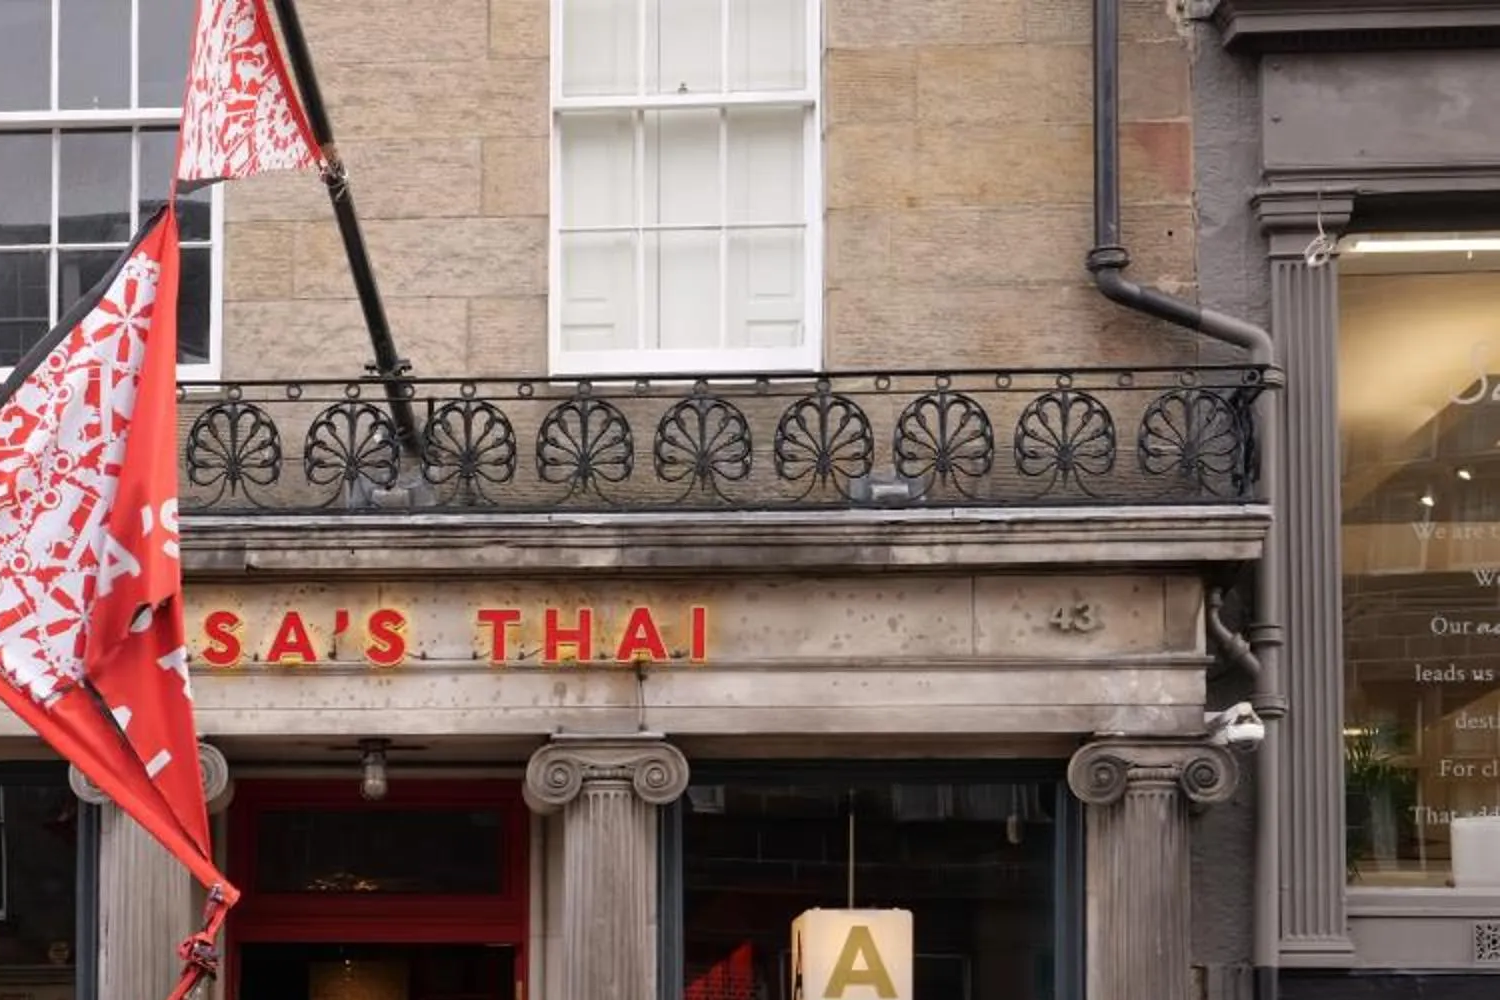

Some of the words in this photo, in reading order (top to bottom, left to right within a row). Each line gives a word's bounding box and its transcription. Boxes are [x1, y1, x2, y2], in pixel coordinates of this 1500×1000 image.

[1049, 603, 1097, 631] 43
[1430, 616, 1473, 635] Our
[201, 608, 407, 665] SA'S
[476, 606, 706, 664] THAI
[1415, 663, 1465, 682] leads
[1472, 669, 1494, 682] us
[1440, 759, 1476, 777] For
[821, 925, 899, 999] A
